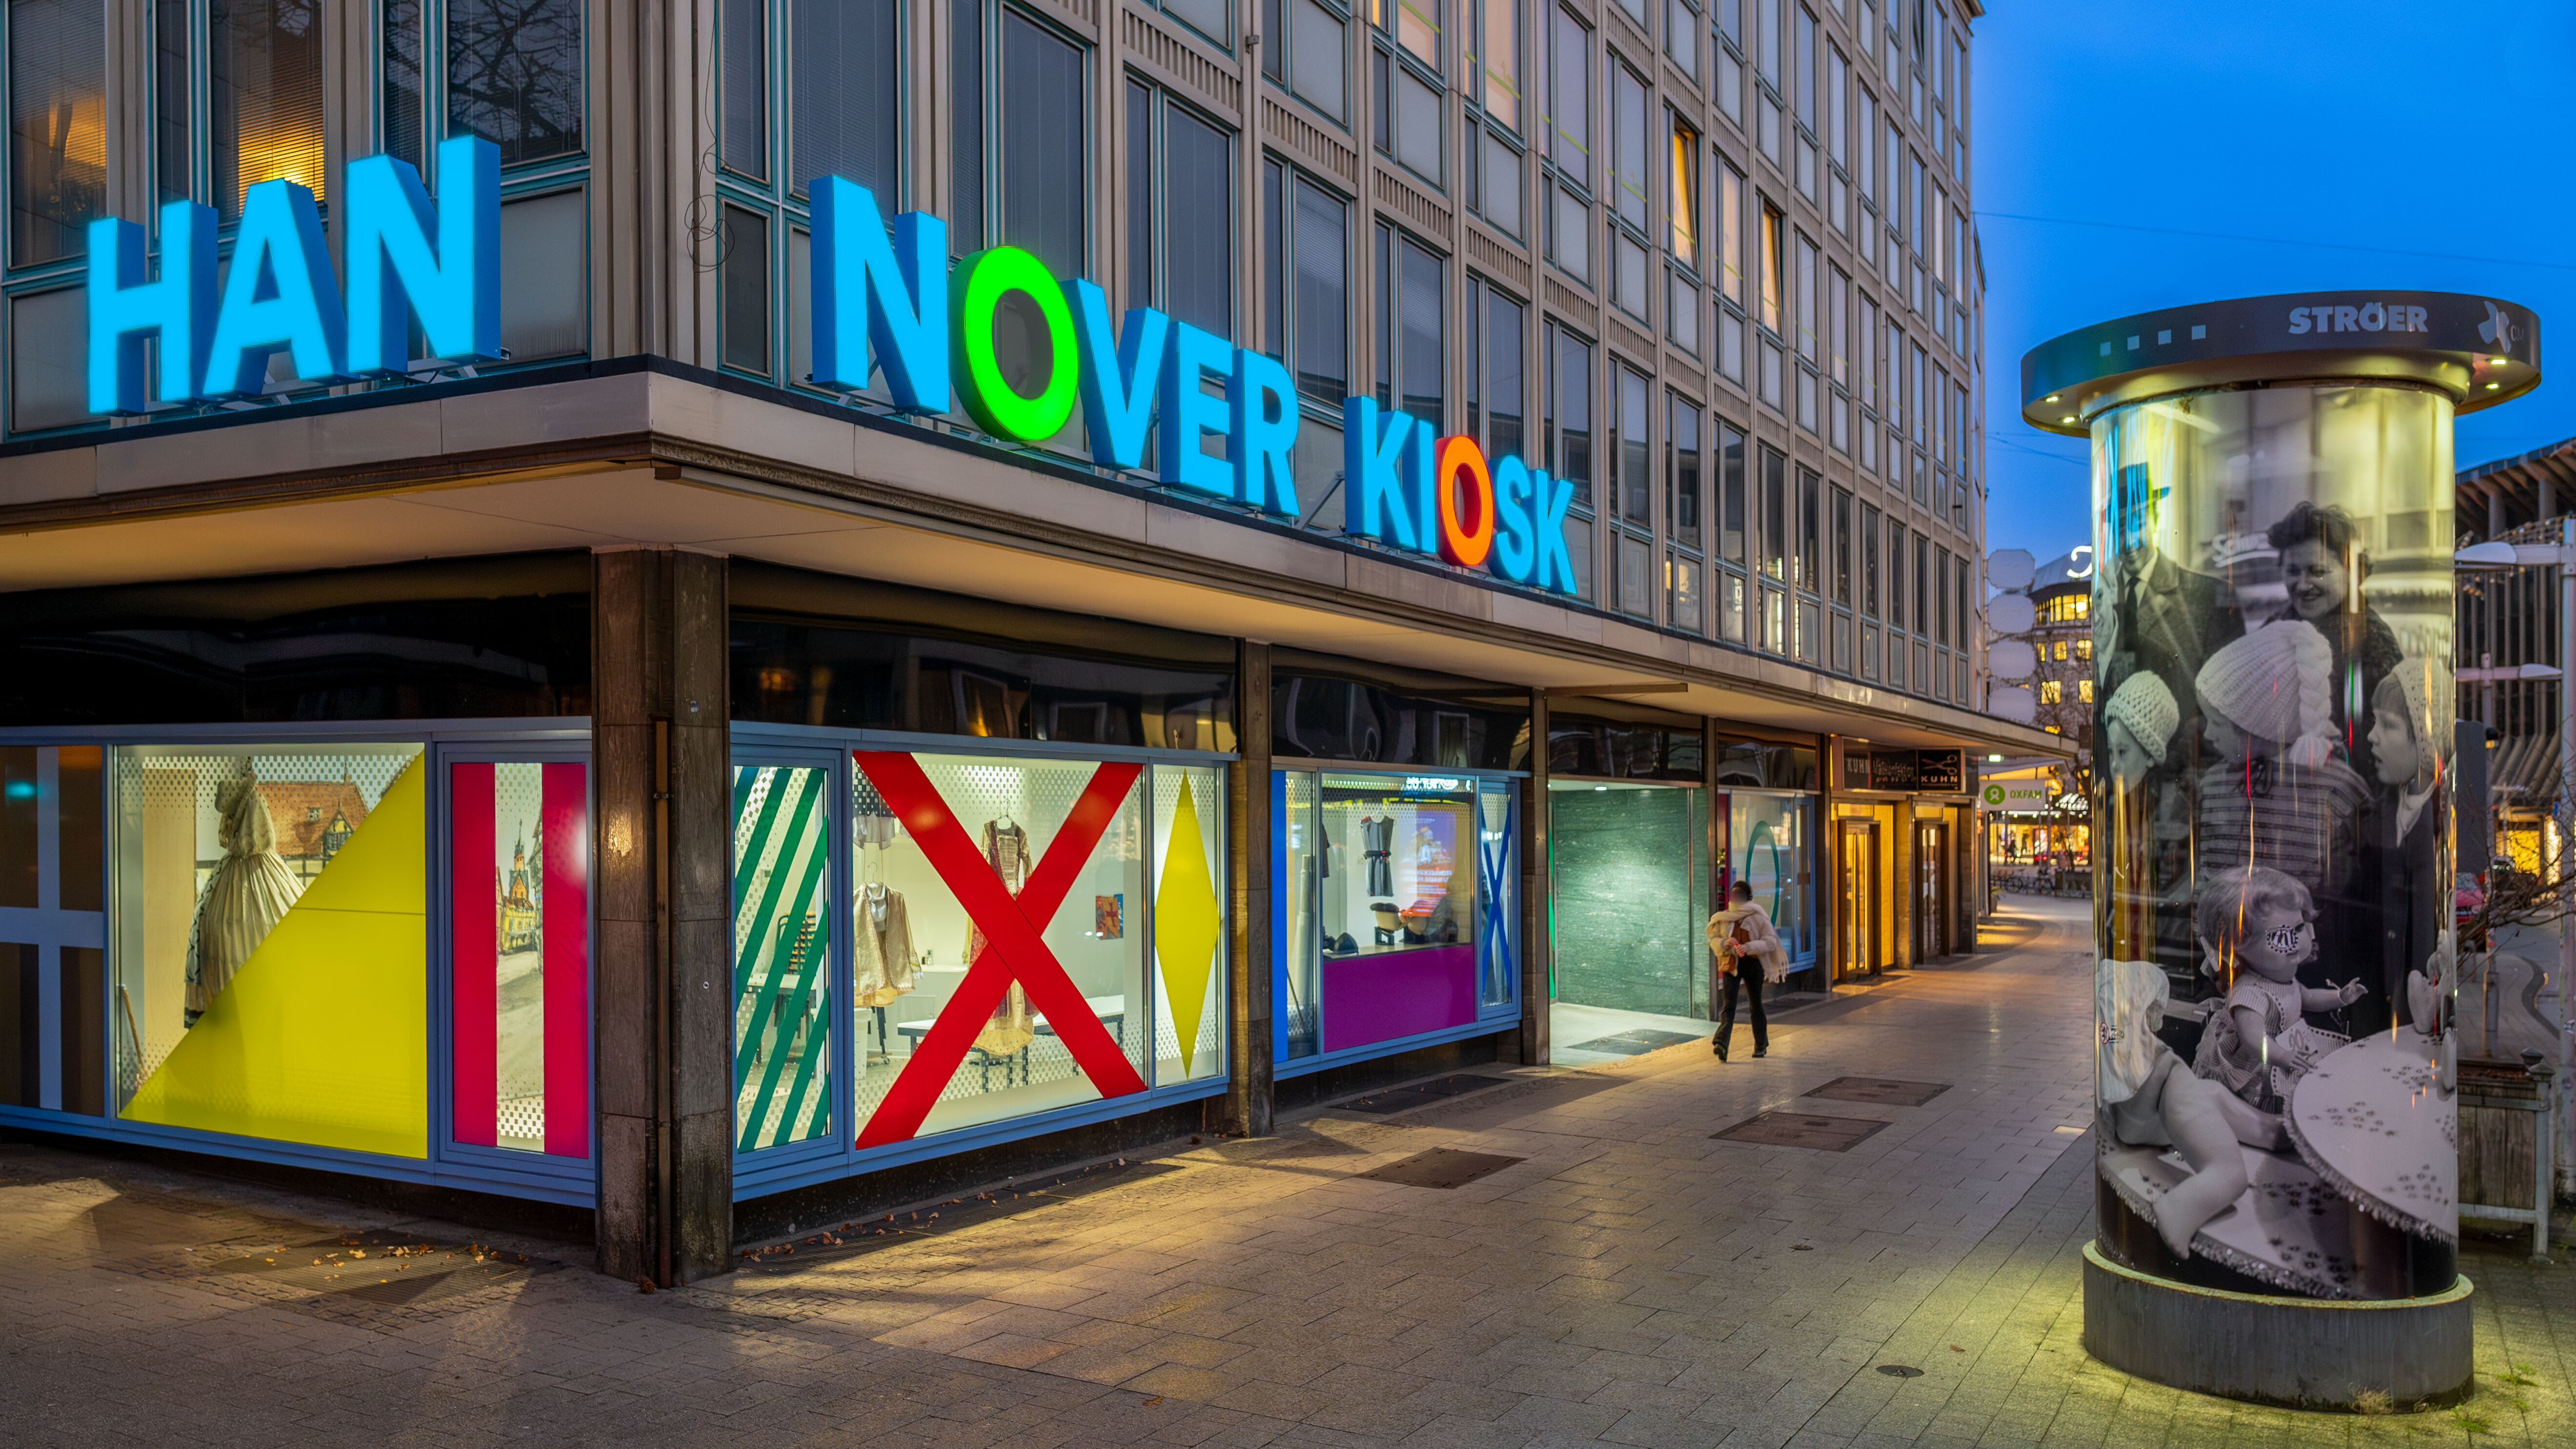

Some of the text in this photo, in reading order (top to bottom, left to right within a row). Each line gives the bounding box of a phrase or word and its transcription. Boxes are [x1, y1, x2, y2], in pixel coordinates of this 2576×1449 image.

[88, 134, 501, 415] HAN
[2288, 301, 2429, 334] STRÖER
[808, 174, 1577, 595] NOVER KIOSK
[2009, 789, 2042, 799] OXFAM
